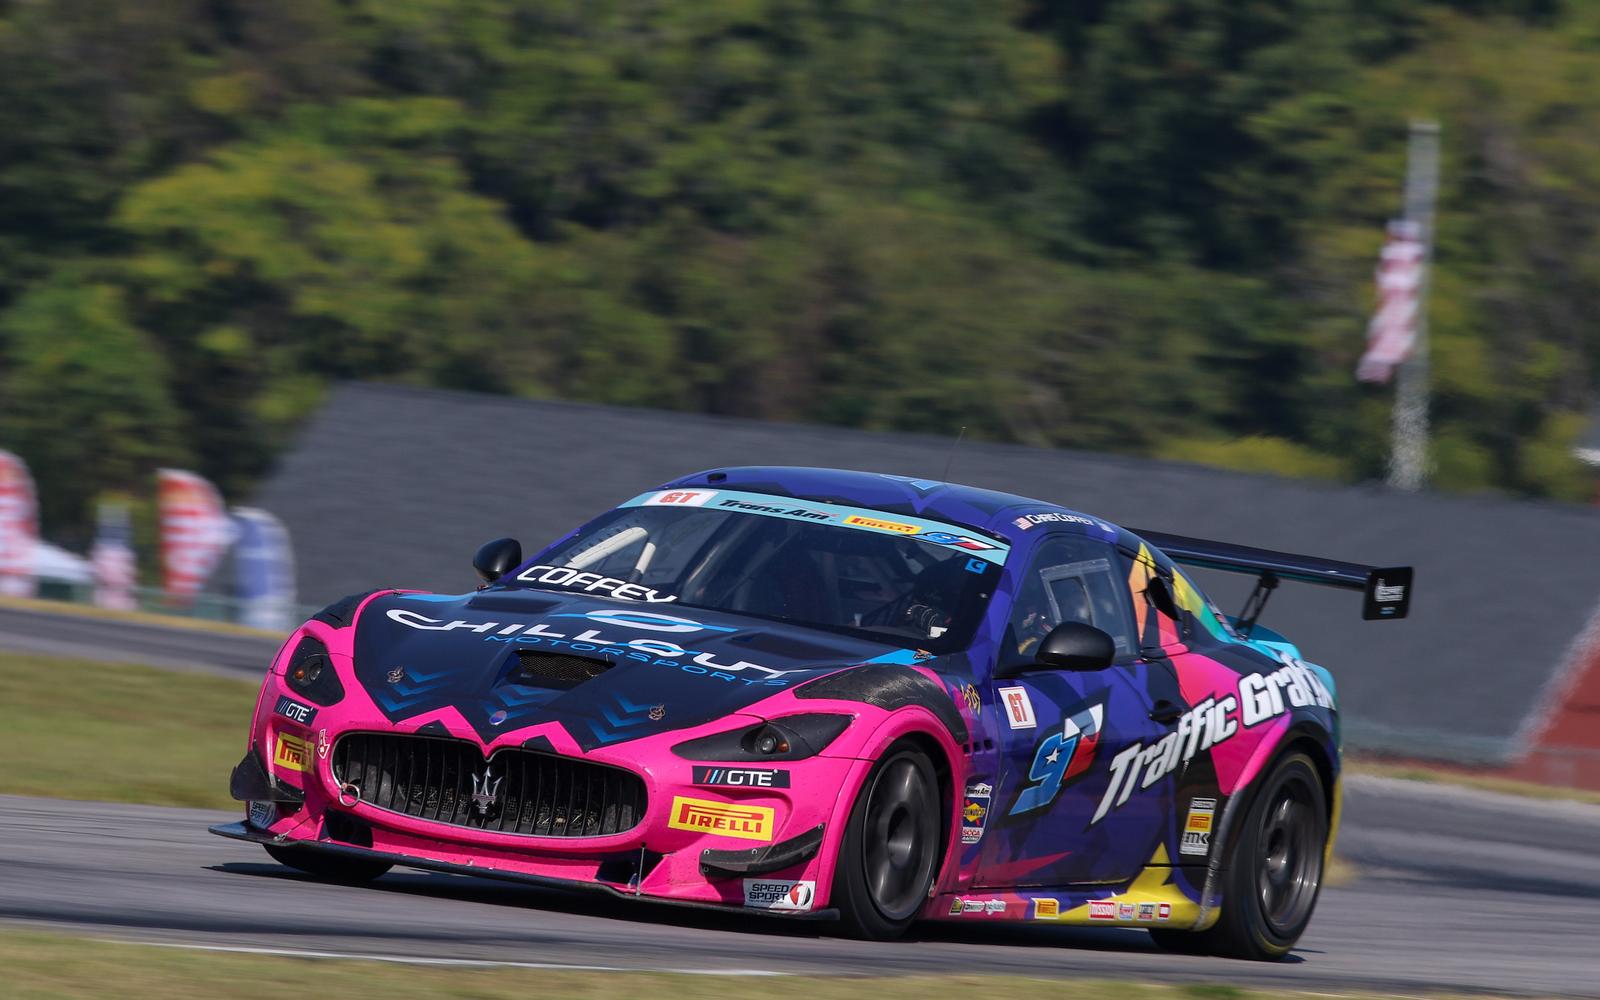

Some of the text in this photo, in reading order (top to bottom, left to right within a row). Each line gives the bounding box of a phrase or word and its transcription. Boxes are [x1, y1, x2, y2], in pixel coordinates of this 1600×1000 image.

[659, 492, 700, 504] GT
[719, 499, 830, 521] Trans Am
[516, 565, 678, 603] COFFEY
[484, 635, 790, 687] MOTORSPORTS
[1007, 693, 1028, 723] GT
[727, 770, 773, 787] GTE
[678, 803, 764, 833] PIRELLI
[749, 892, 787, 901] SPORT
[752, 883, 789, 893] SPEED
